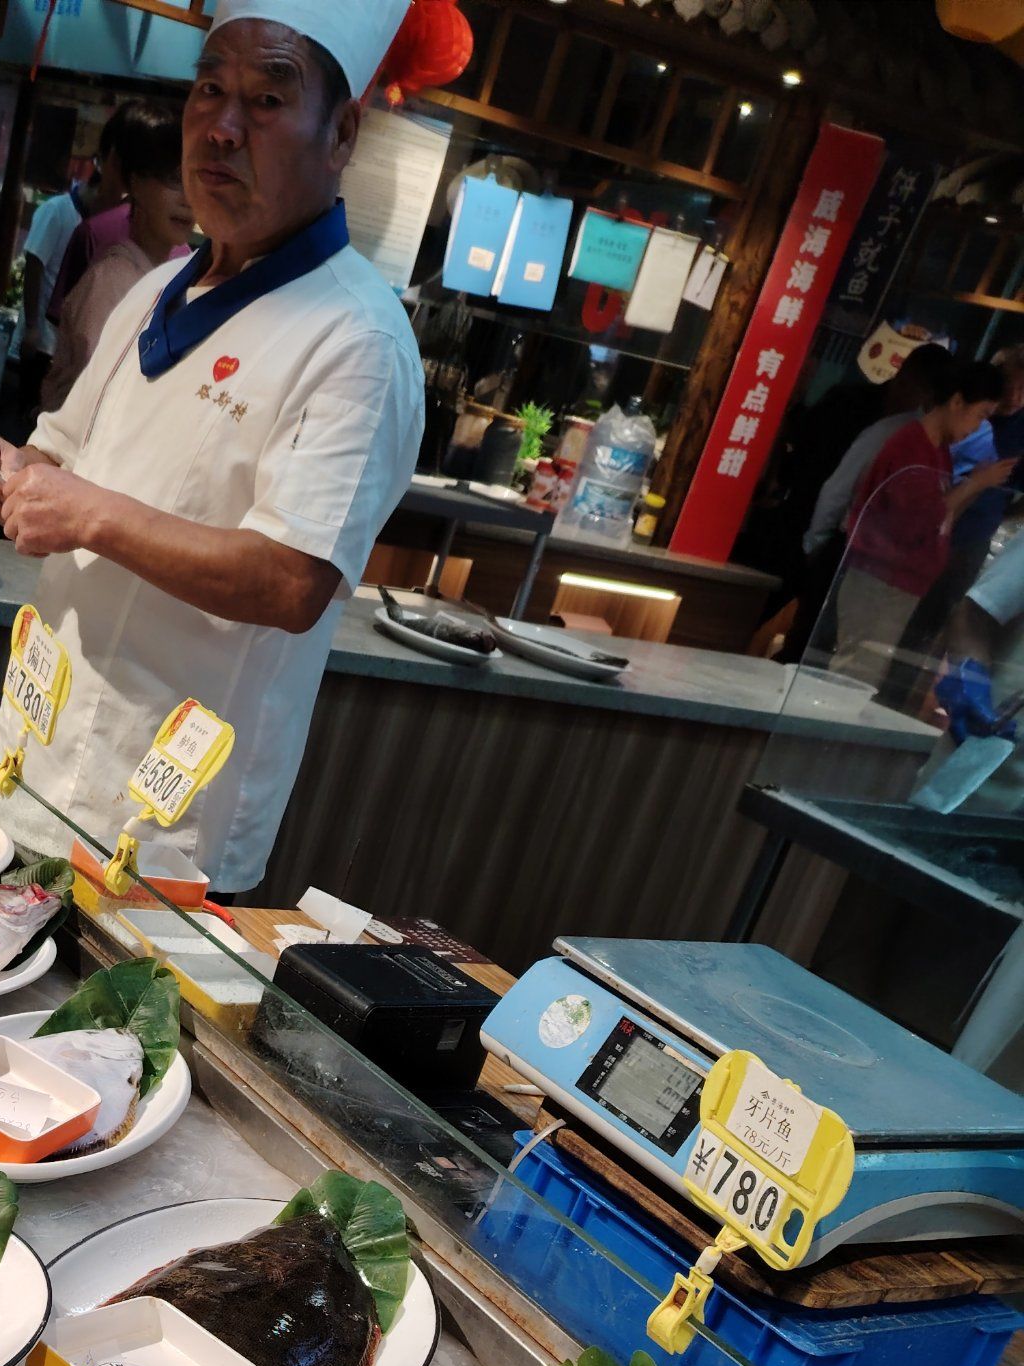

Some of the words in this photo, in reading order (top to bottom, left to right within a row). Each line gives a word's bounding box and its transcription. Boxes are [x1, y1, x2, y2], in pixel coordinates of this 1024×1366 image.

[716, 347, 785, 478] 有点鲜甜
[27, 640, 51, 683] 偏口
[744, 1095, 793, 1143] 牙片鱼
[744, 1125, 792, 1168] 78元/斤
